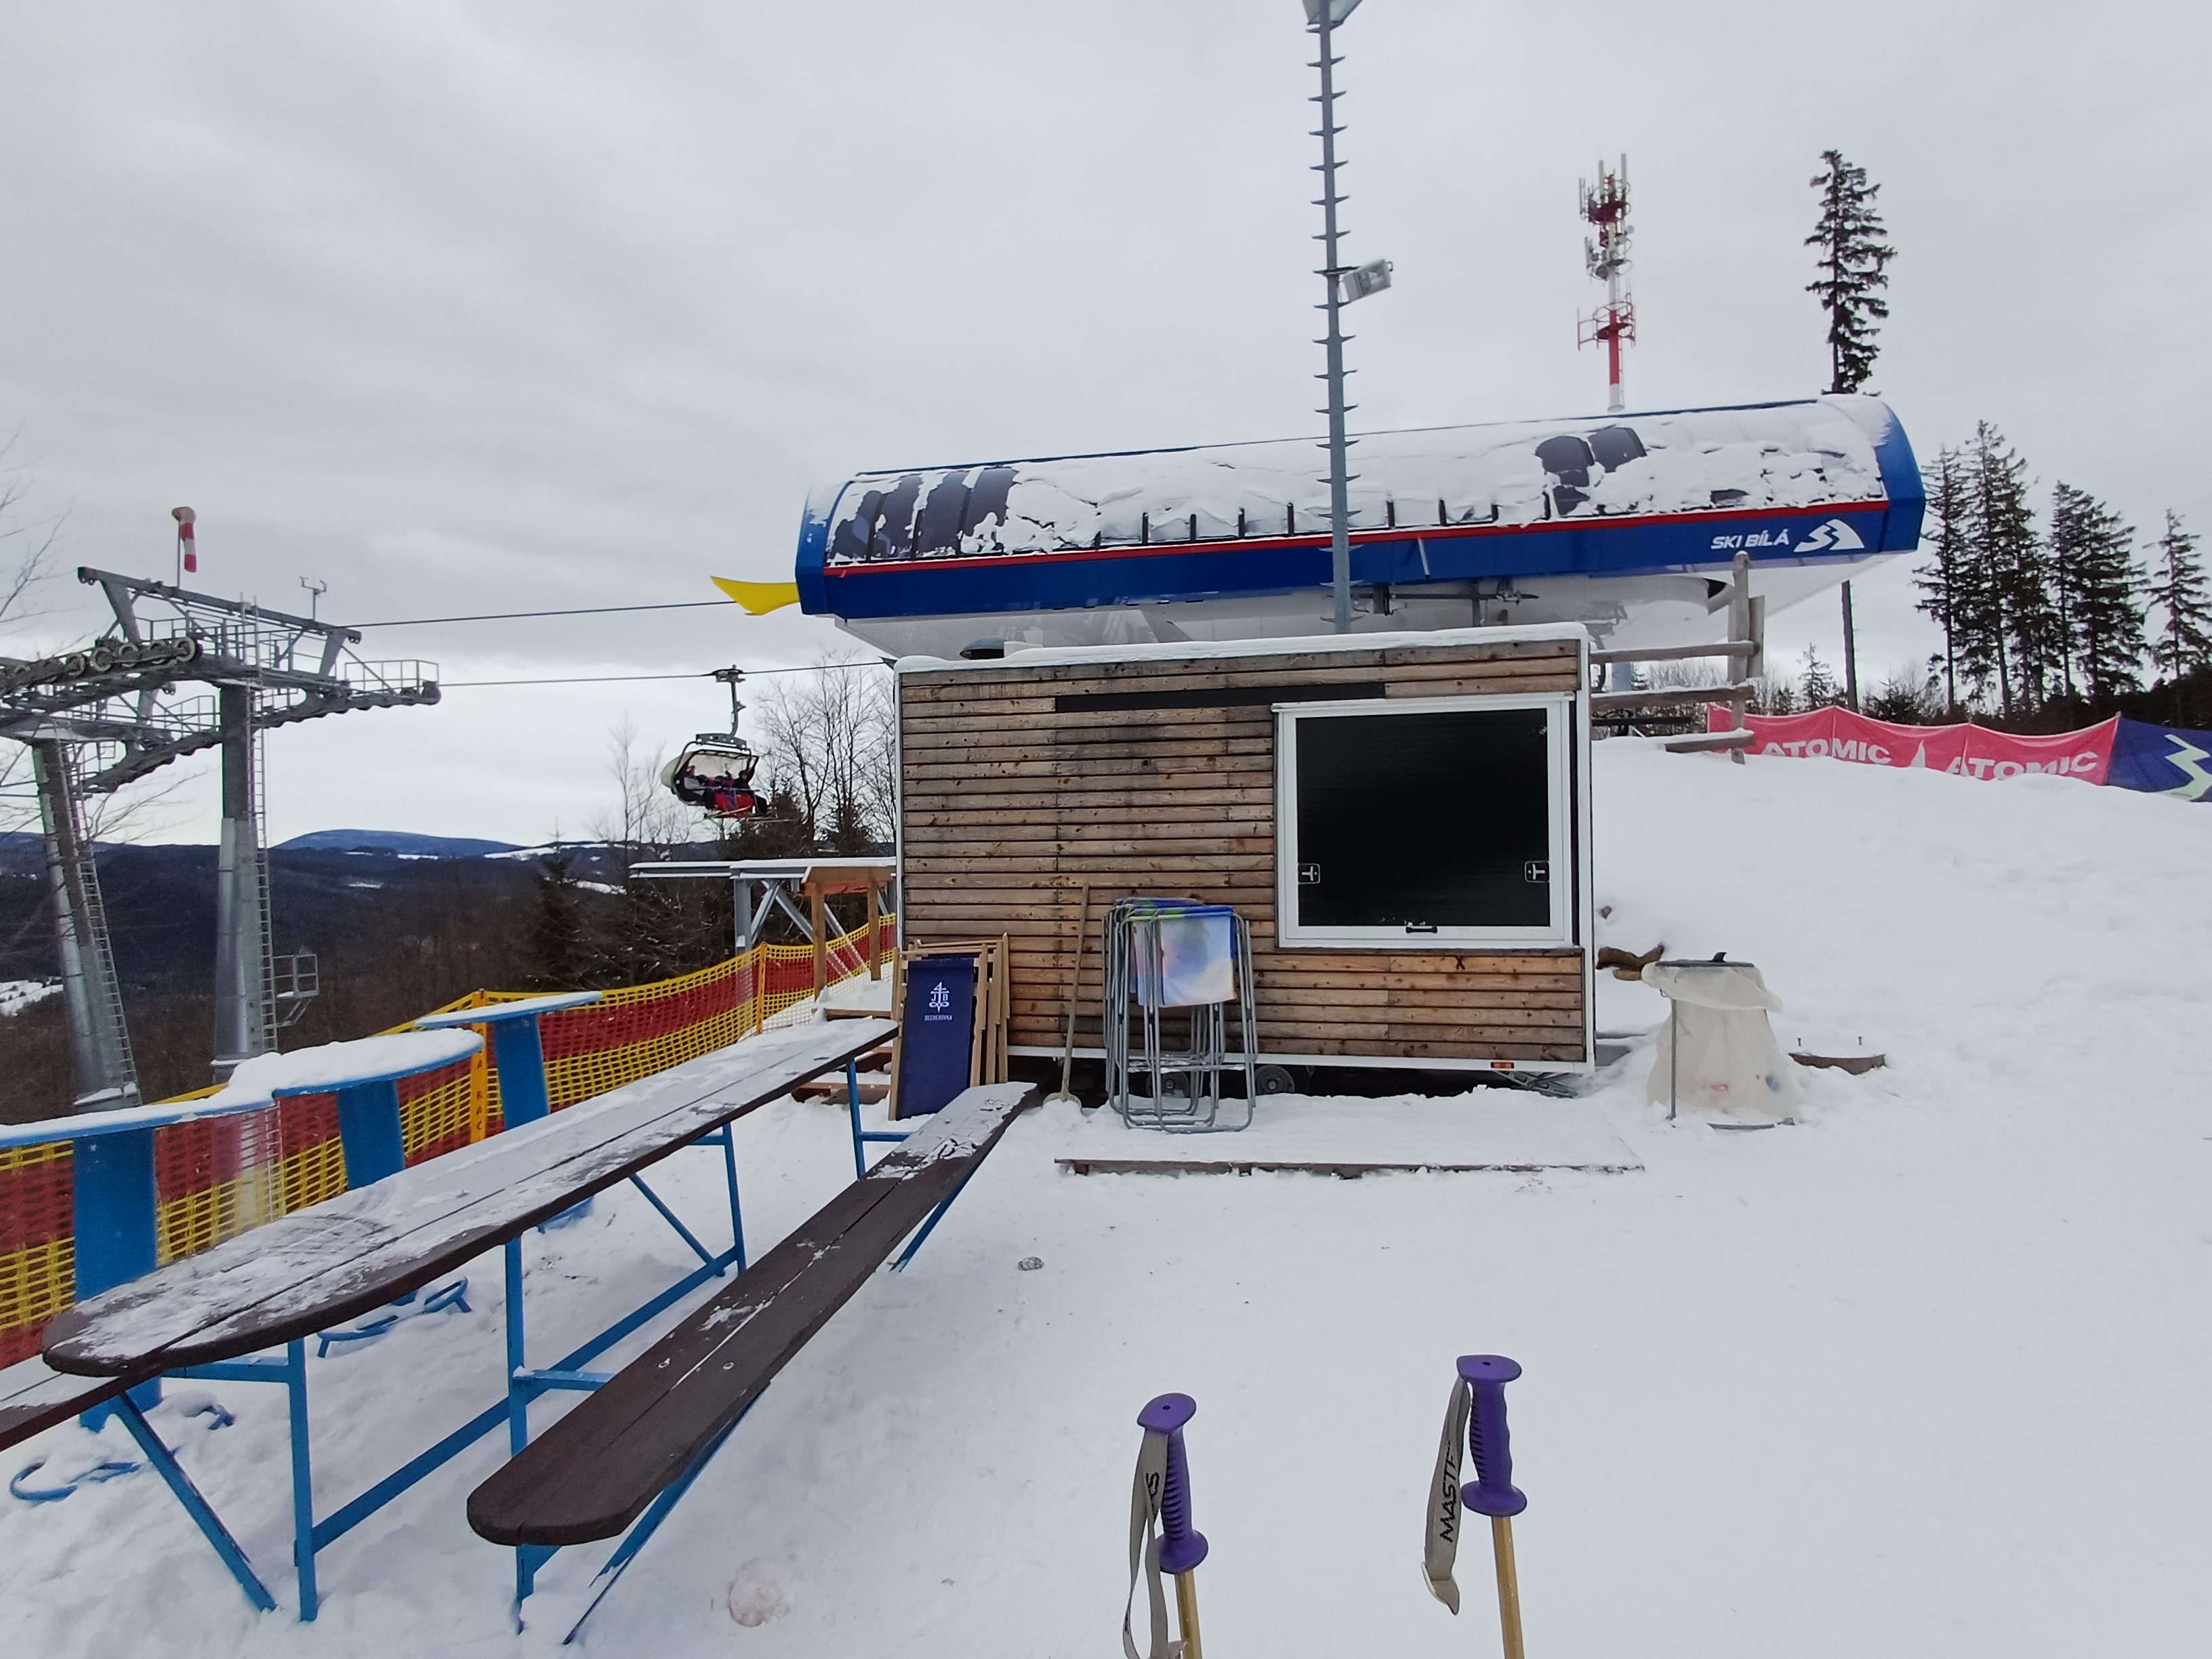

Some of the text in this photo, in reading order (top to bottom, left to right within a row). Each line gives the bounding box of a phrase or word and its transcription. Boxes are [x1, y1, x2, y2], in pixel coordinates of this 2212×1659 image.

[1711, 529, 1789, 550] SKI BÍLÁ
[1762, 738, 1892, 764] ATOMIC
